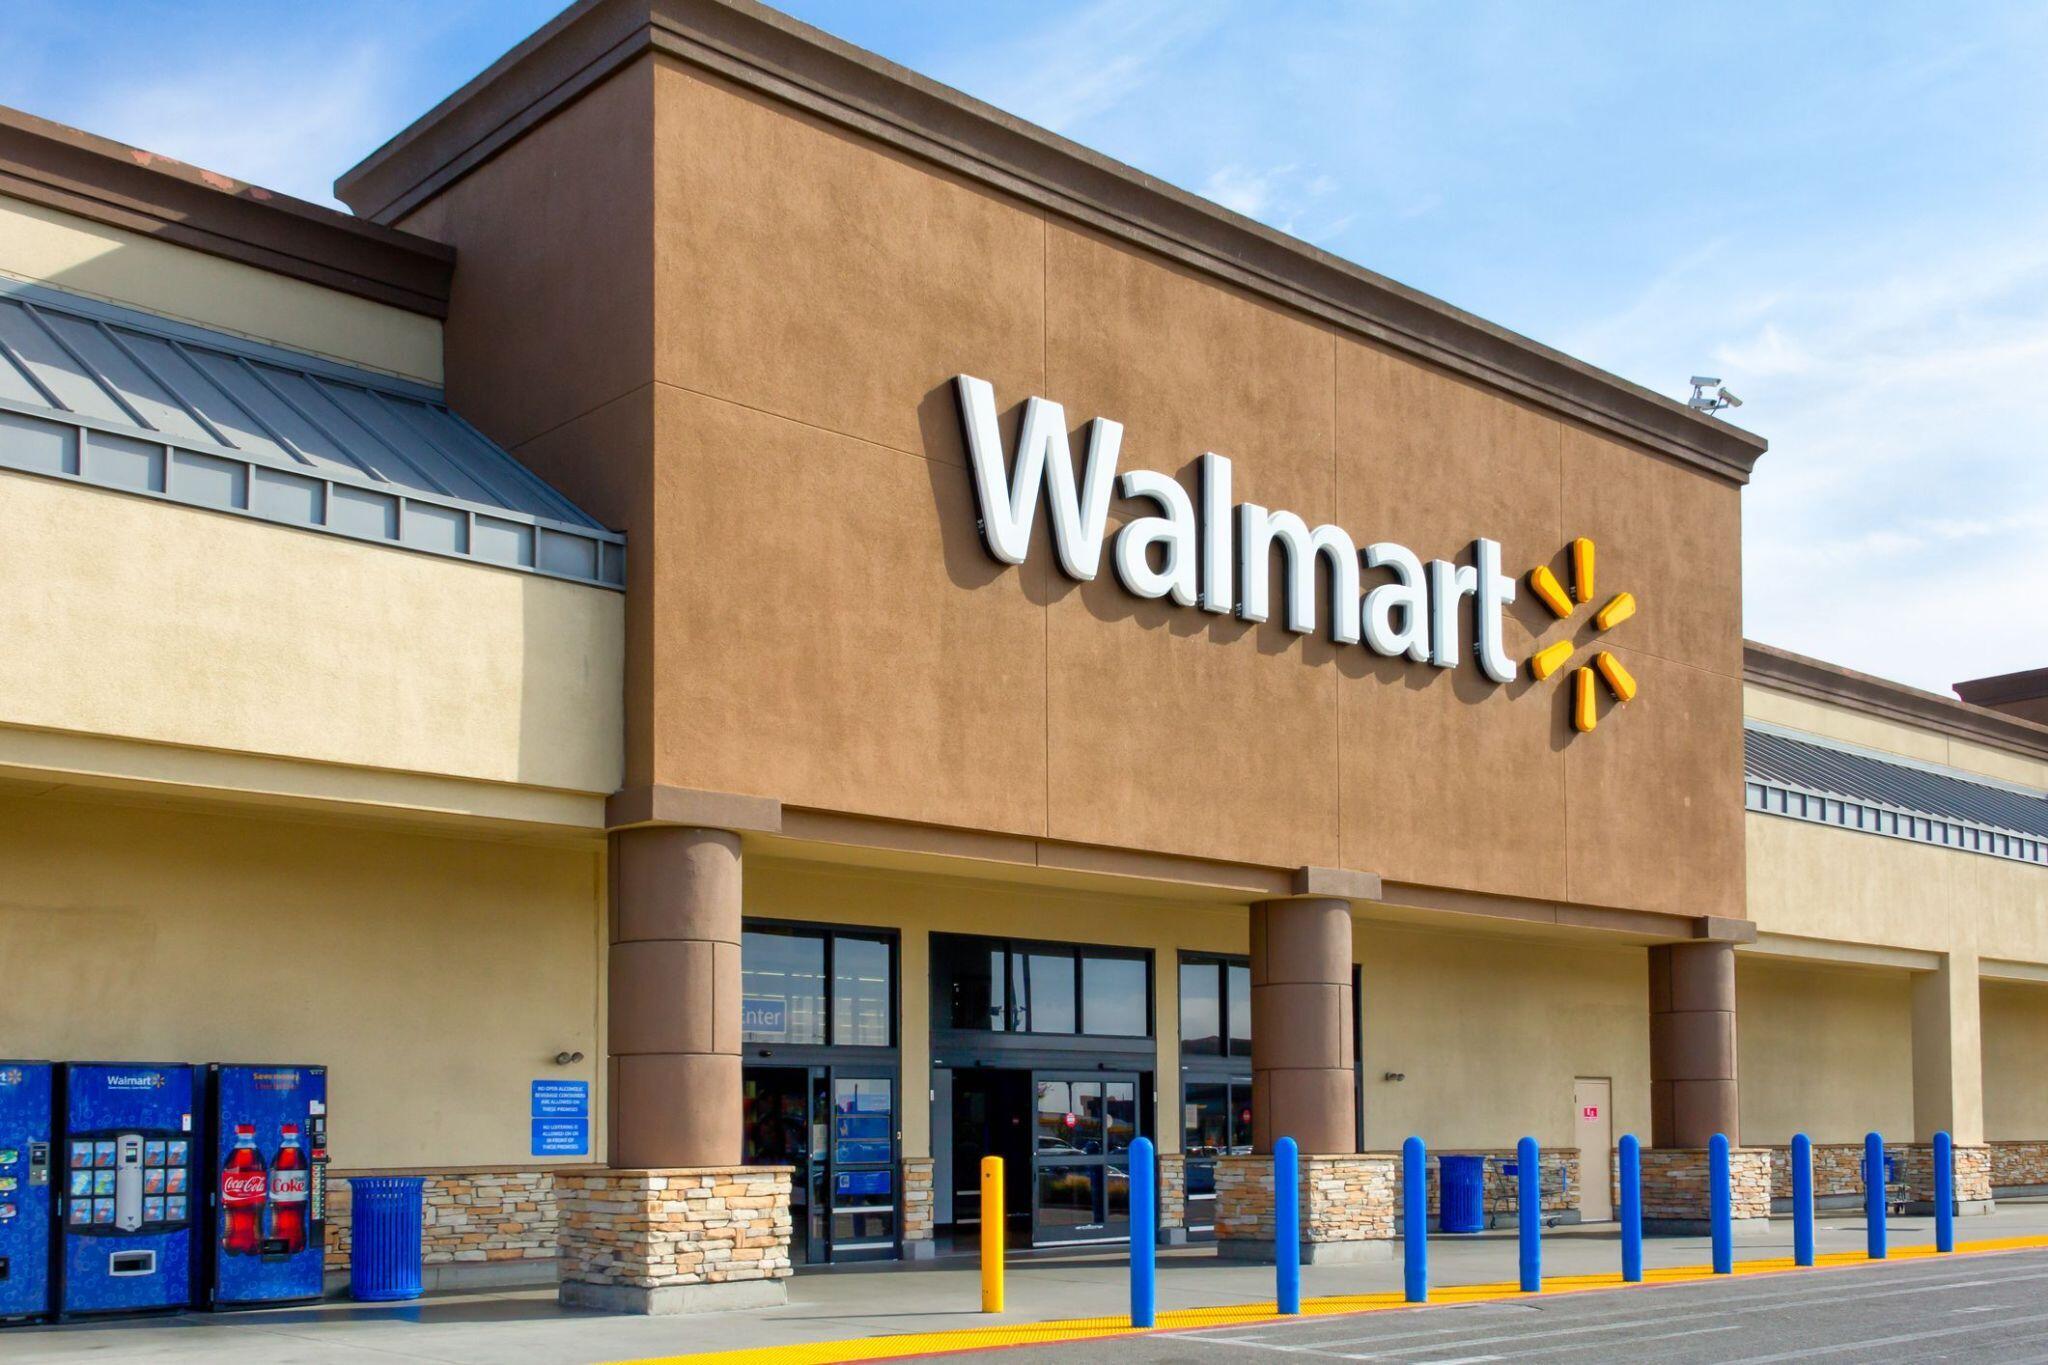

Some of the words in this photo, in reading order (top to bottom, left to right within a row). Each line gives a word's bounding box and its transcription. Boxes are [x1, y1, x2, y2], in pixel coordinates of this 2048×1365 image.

[952, 374, 1517, 682] Walmart
[107, 1075, 151, 1085] Walmart
[224, 1176, 265, 1193] Coca-Cola
[272, 1178, 304, 1193] Coke
